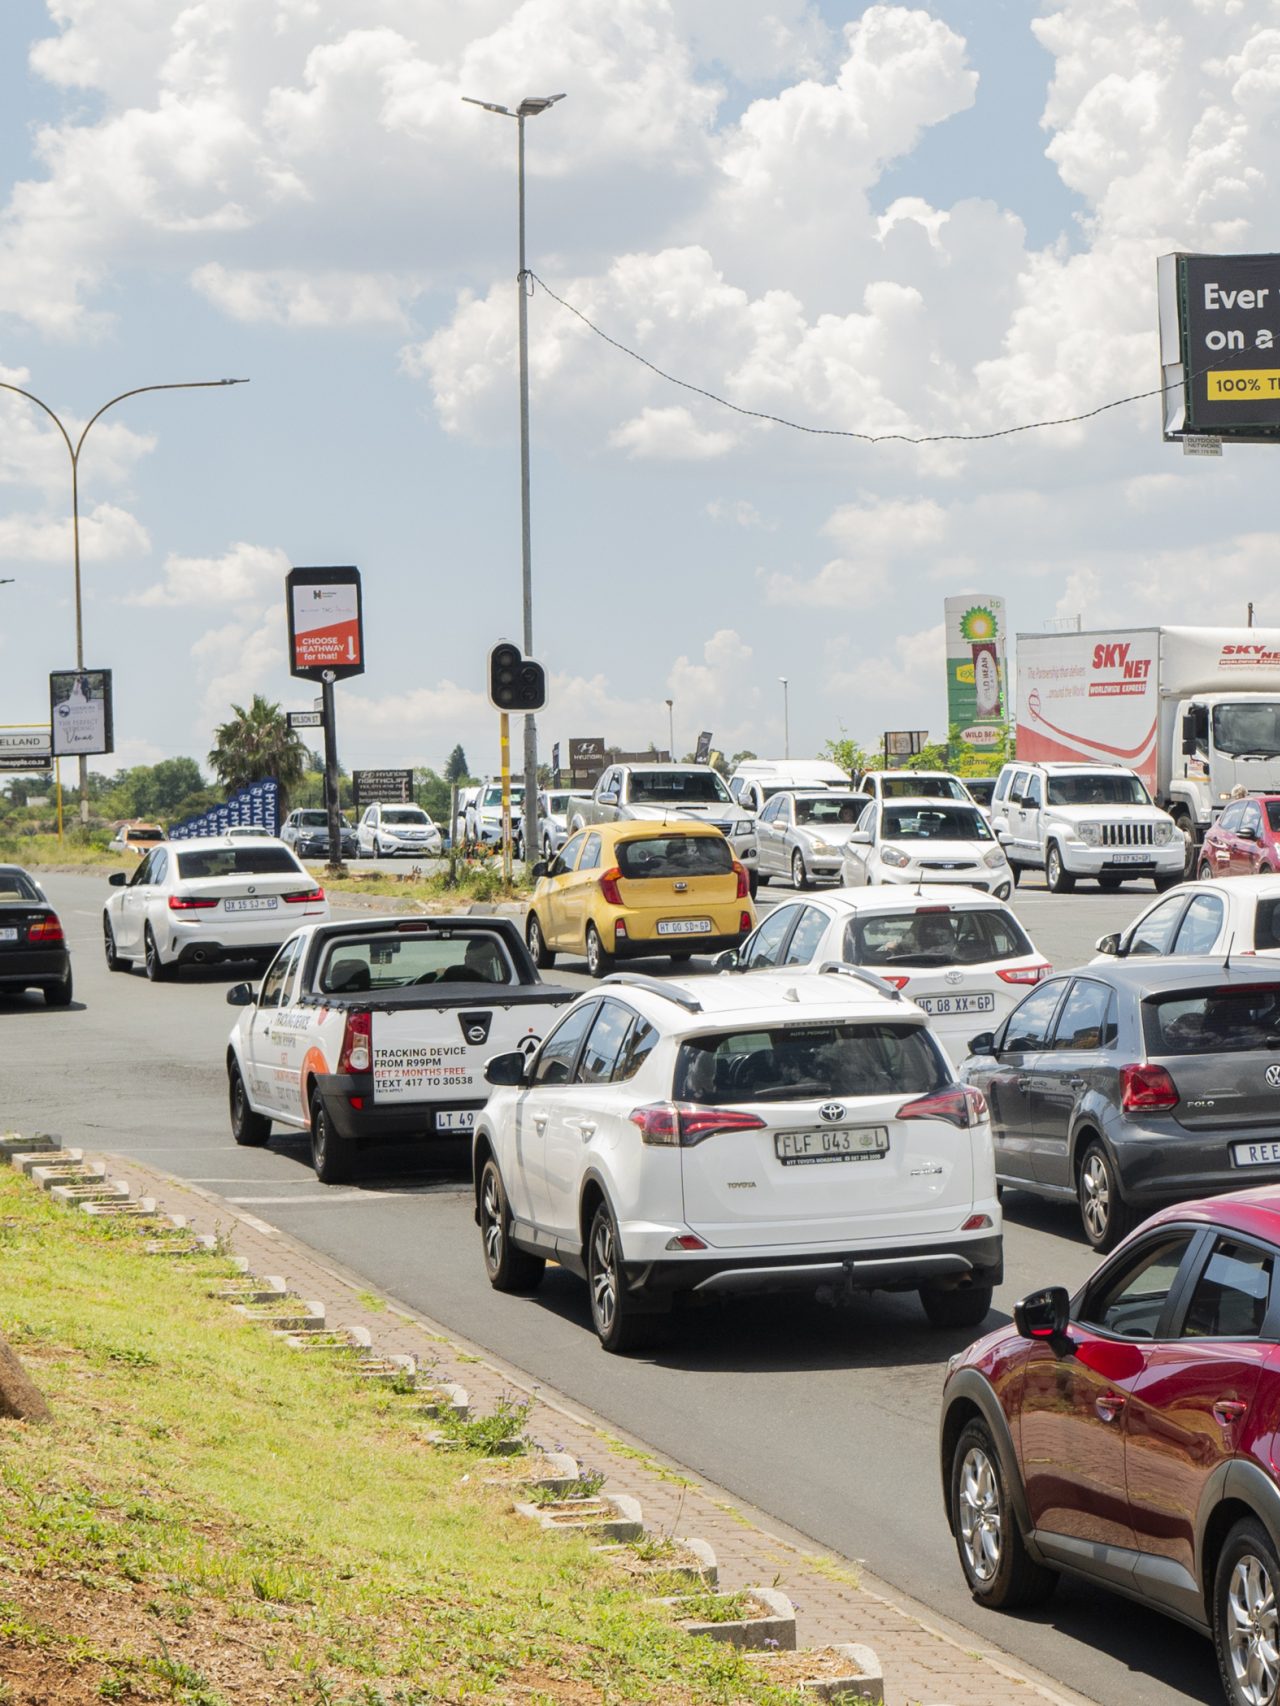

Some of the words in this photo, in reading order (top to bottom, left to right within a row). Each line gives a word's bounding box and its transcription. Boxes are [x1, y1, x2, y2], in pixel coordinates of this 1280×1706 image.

[1204, 282, 1269, 310] Ever
[1205, 329, 1245, 350] on
[1255, 328, 1273, 349] a
[1216, 378, 1261, 392] 100%
[302, 637, 338, 645] CHOOSE
[296, 644, 345, 653] HEATHWAY
[1222, 645, 1266, 655] SKY
[317, 652, 337, 660] that!
[1092, 643, 1131, 669] SKY
[1123, 660, 1151, 679] NET
[267, 899, 276, 908] GP
[700, 922, 709, 930] GP
[918, 1000, 932, 1013] HC
[937, 999, 950, 1012] 08
[956, 998, 968, 1011] XX
[978, 996, 991, 1009] GP
[375, 1049, 427, 1058] TRACKING
[430, 1047, 467, 1056] DEVICE
[375, 1059, 403, 1068] FROM
[407, 1058, 442, 1067] R99PM
[375, 1069, 393, 1079] GET
[394, 1069, 402, 1078] 2
[402, 1068, 442, 1077] MONTHS
[444, 1067, 466, 1076] FREE
[376, 1080, 402, 1088] TEXT
[405, 1078, 423, 1087] 417
[427, 1078, 440, 1086] TO
[443, 1077, 473, 1086] 30538
[1187, 1100, 1215, 1108] POLO
[438, 1113, 454, 1127] LT
[459, 1112, 474, 1126] 49
[783, 1134, 812, 1155] FLF
[822, 1131, 851, 1151] 043
[875, 1130, 884, 1147] L
[727, 1181, 756, 1189] TOYOTA
